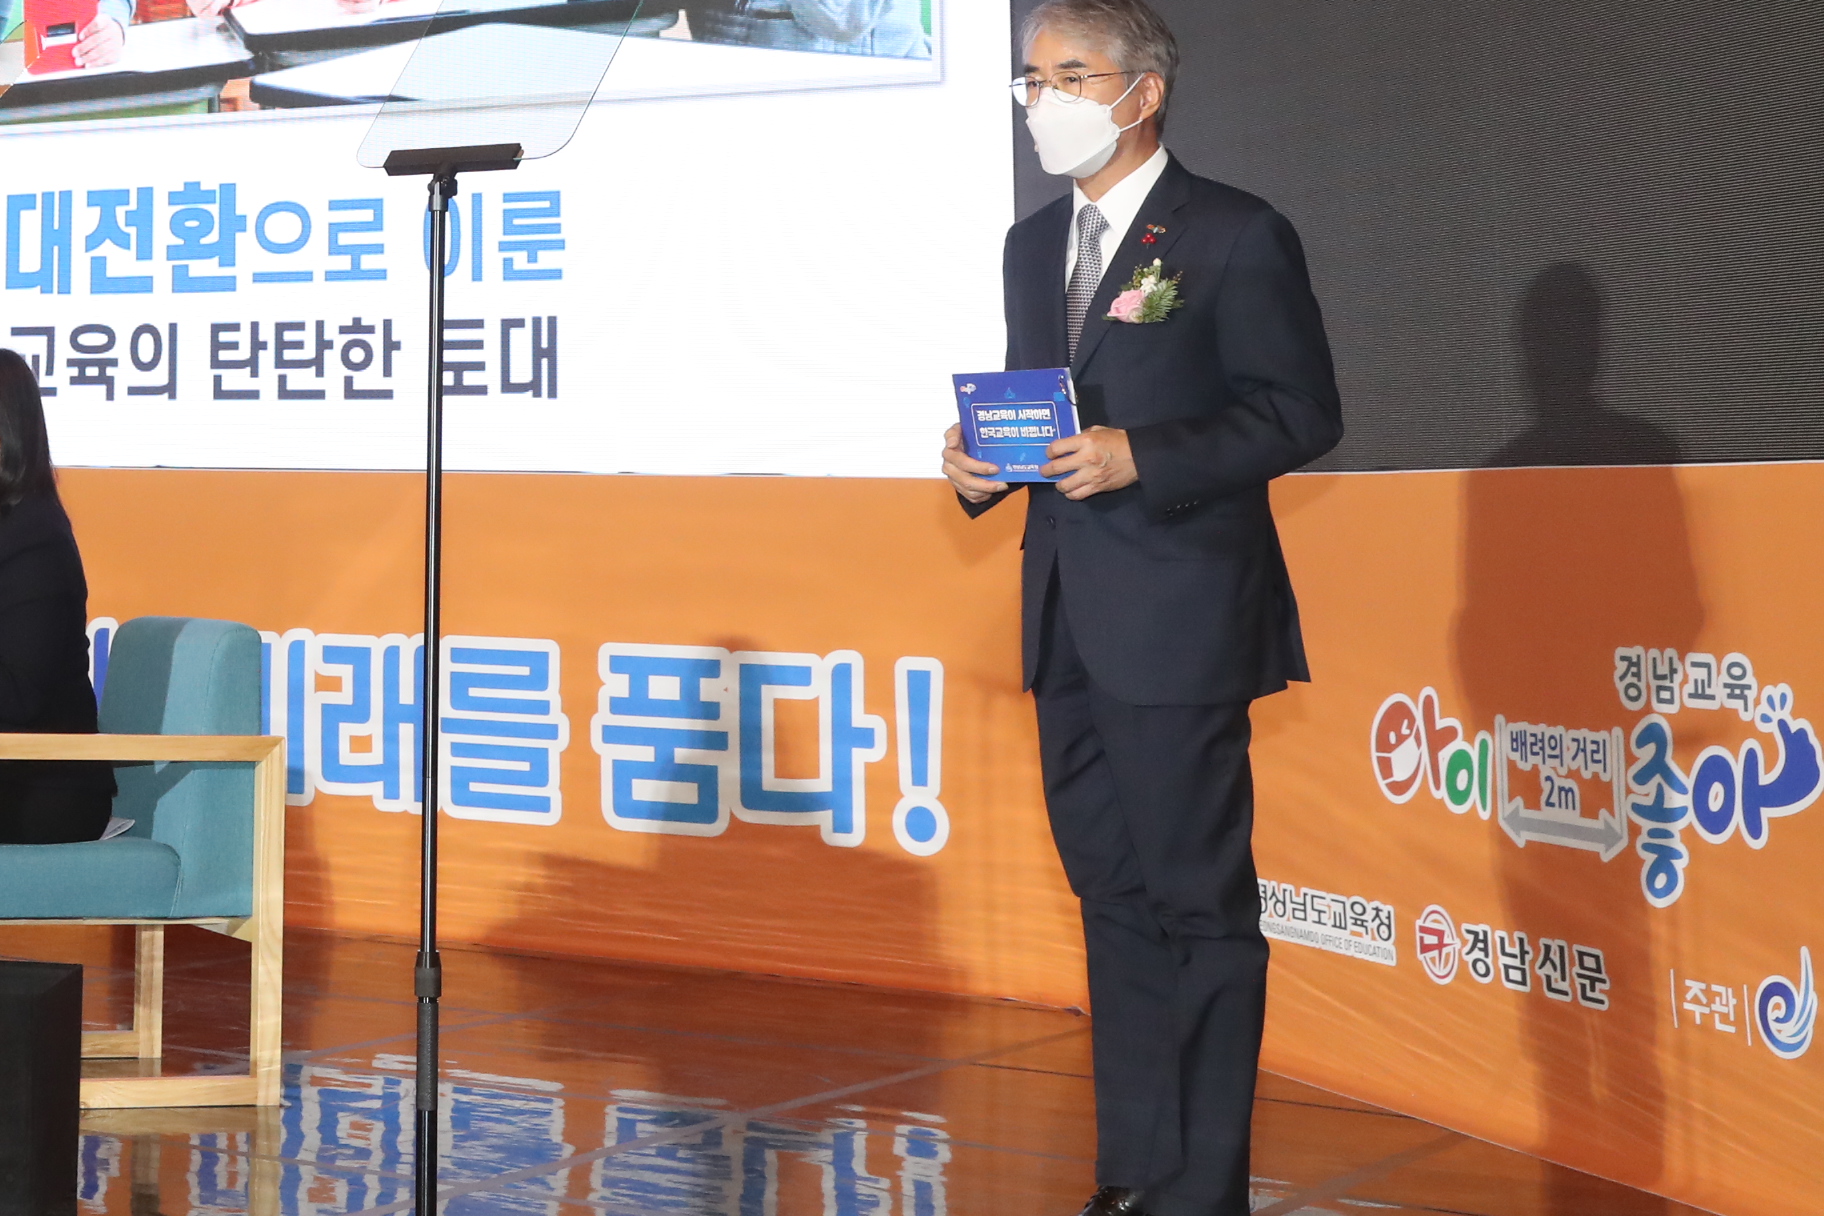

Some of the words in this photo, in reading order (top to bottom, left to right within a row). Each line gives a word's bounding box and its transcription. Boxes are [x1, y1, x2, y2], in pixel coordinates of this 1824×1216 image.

[424, 189, 567, 284] 이룬
[209, 316, 402, 402] 탄탄한
[438, 314, 562, 401] 토대
[1618, 652, 1753, 715] 경남교육
[590, 642, 952, 858] 품다!
[1510, 728, 1565, 767] 배려의
[1571, 734, 1608, 774] 거리
[1544, 775, 1577, 811] 2m
[1464, 926, 1609, 1007] 경남신문
[1683, 978, 1738, 1034] 주관
